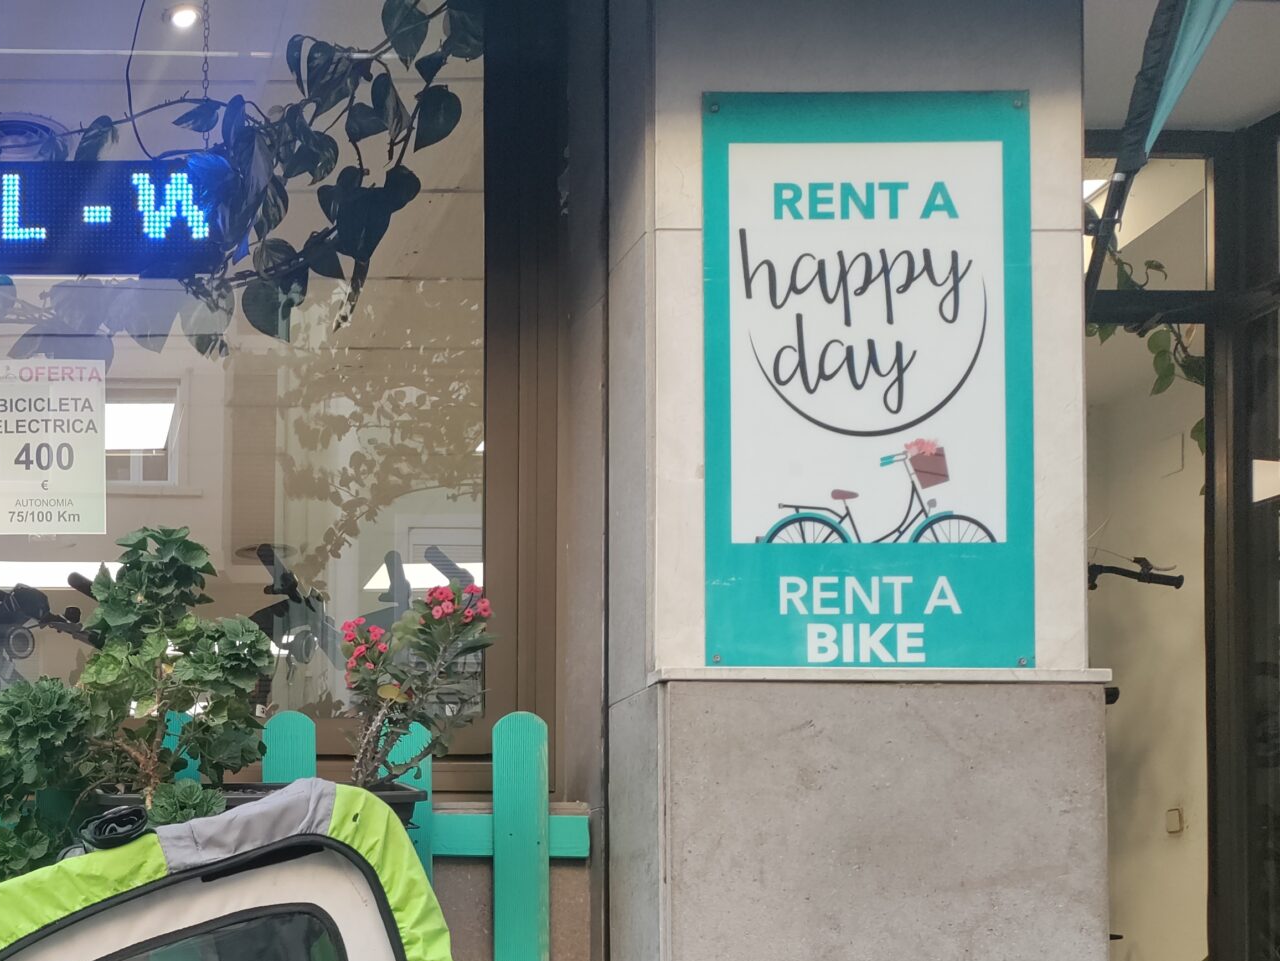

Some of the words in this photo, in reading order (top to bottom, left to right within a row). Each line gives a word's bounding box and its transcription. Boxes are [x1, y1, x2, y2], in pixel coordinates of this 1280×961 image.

[772, 182, 908, 220] RENT
[919, 181, 959, 220] A
[738, 228, 973, 327] happy
[18, 366, 103, 382] OFERTA
[773, 313, 918, 414] day
[14, 442, 75, 471] 400
[41, 479, 49, 491] €
[8, 511, 53, 523] 75/100
[57, 510, 81, 523] Km
[15, 498, 74, 507] AUTONOMIA
[778, 576, 913, 615] RENT
[923, 576, 963, 615] A
[806, 623, 926, 663] BIKE
